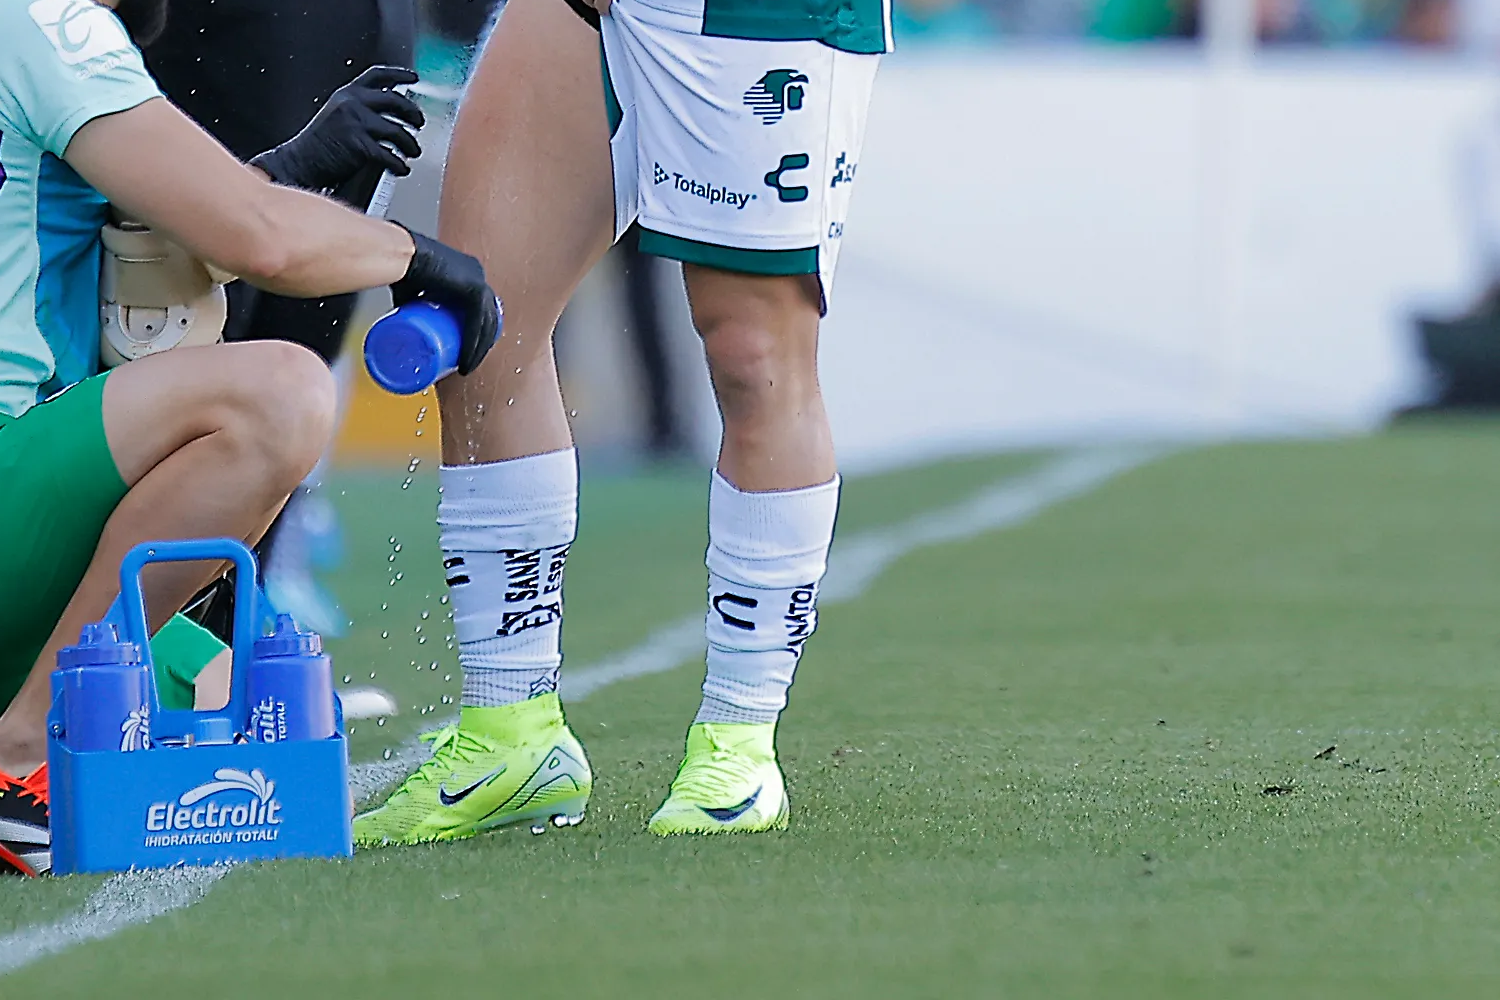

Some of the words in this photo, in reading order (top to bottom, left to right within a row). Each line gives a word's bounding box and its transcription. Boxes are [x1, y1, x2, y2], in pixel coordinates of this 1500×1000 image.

[673, 172, 750, 209] Totalplay
[146, 799, 282, 831] Electrolit
[236, 830, 278, 843] TOTAL!
